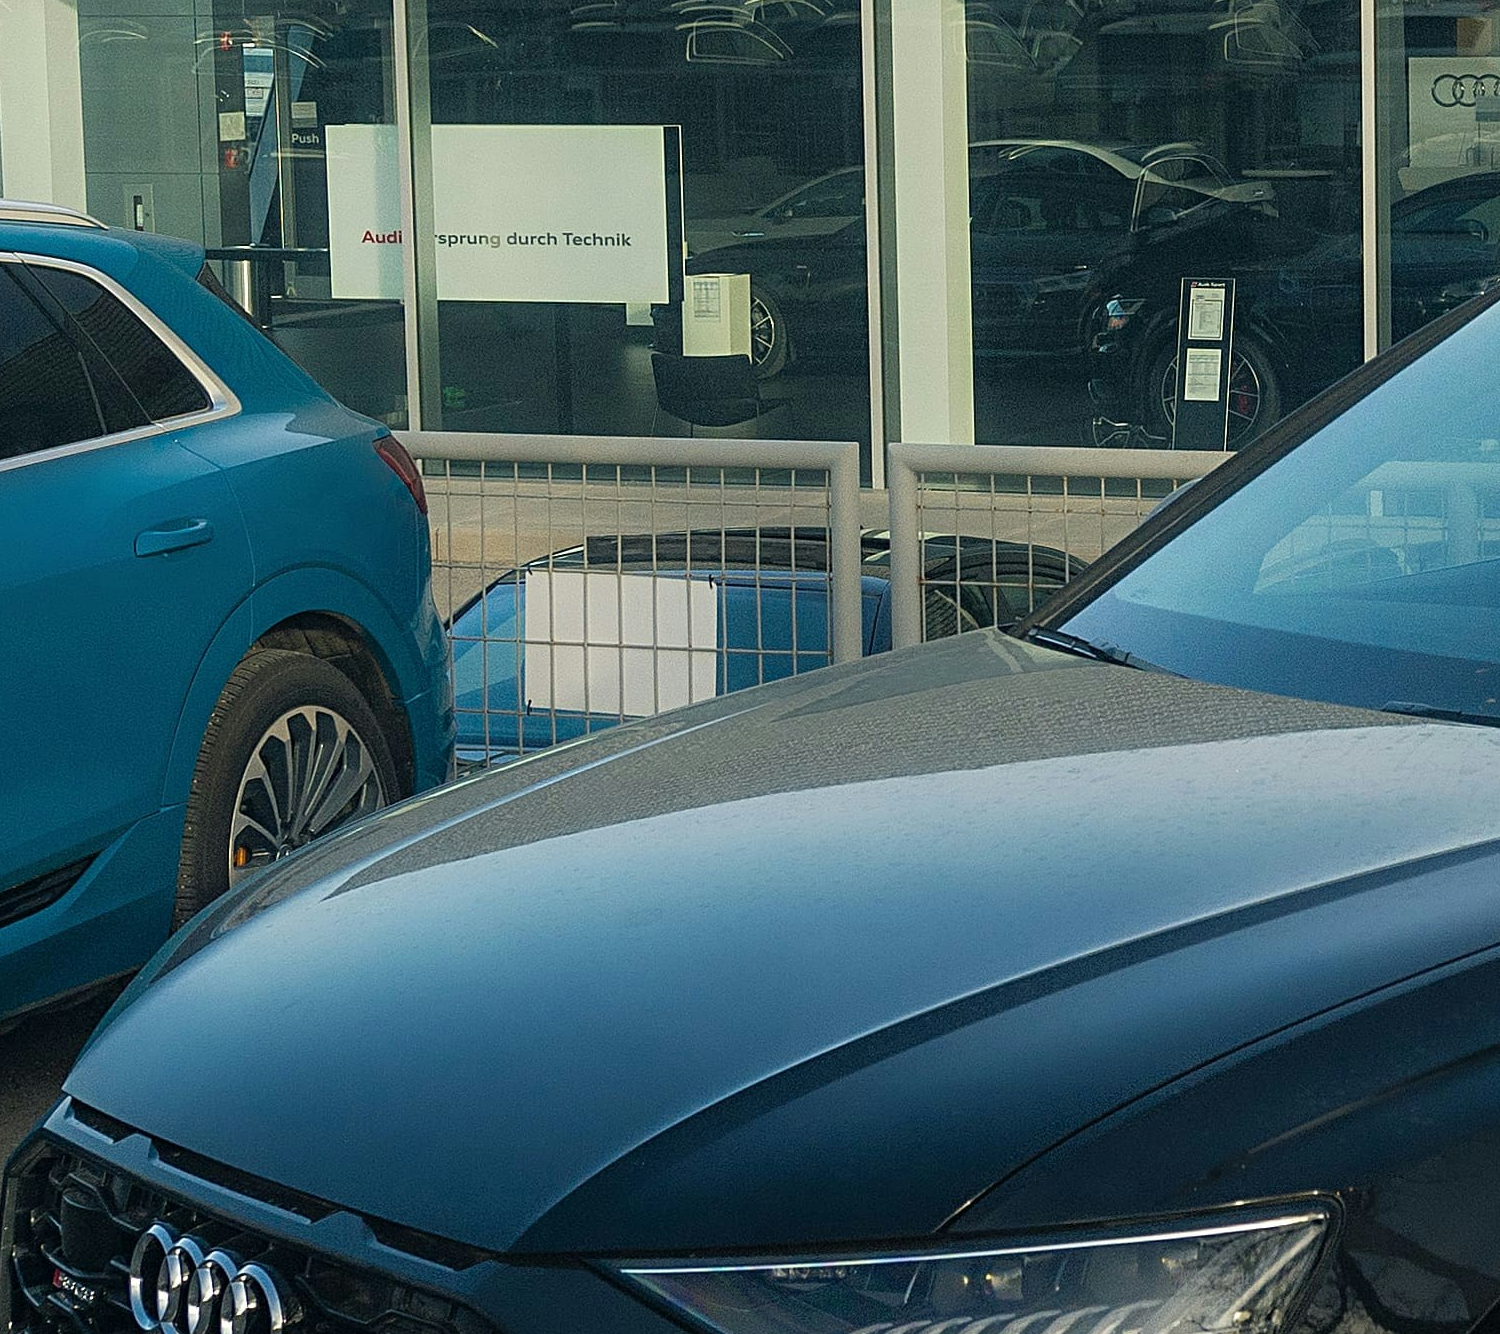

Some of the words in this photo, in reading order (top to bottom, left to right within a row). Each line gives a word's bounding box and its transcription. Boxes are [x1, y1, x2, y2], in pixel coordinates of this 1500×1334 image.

[291, 133, 320, 145] Push
[361, 230, 402, 244] Audi
[434, 234, 501, 248] sprung
[506, 232, 558, 246] durch
[562, 232, 631, 247] Technik
